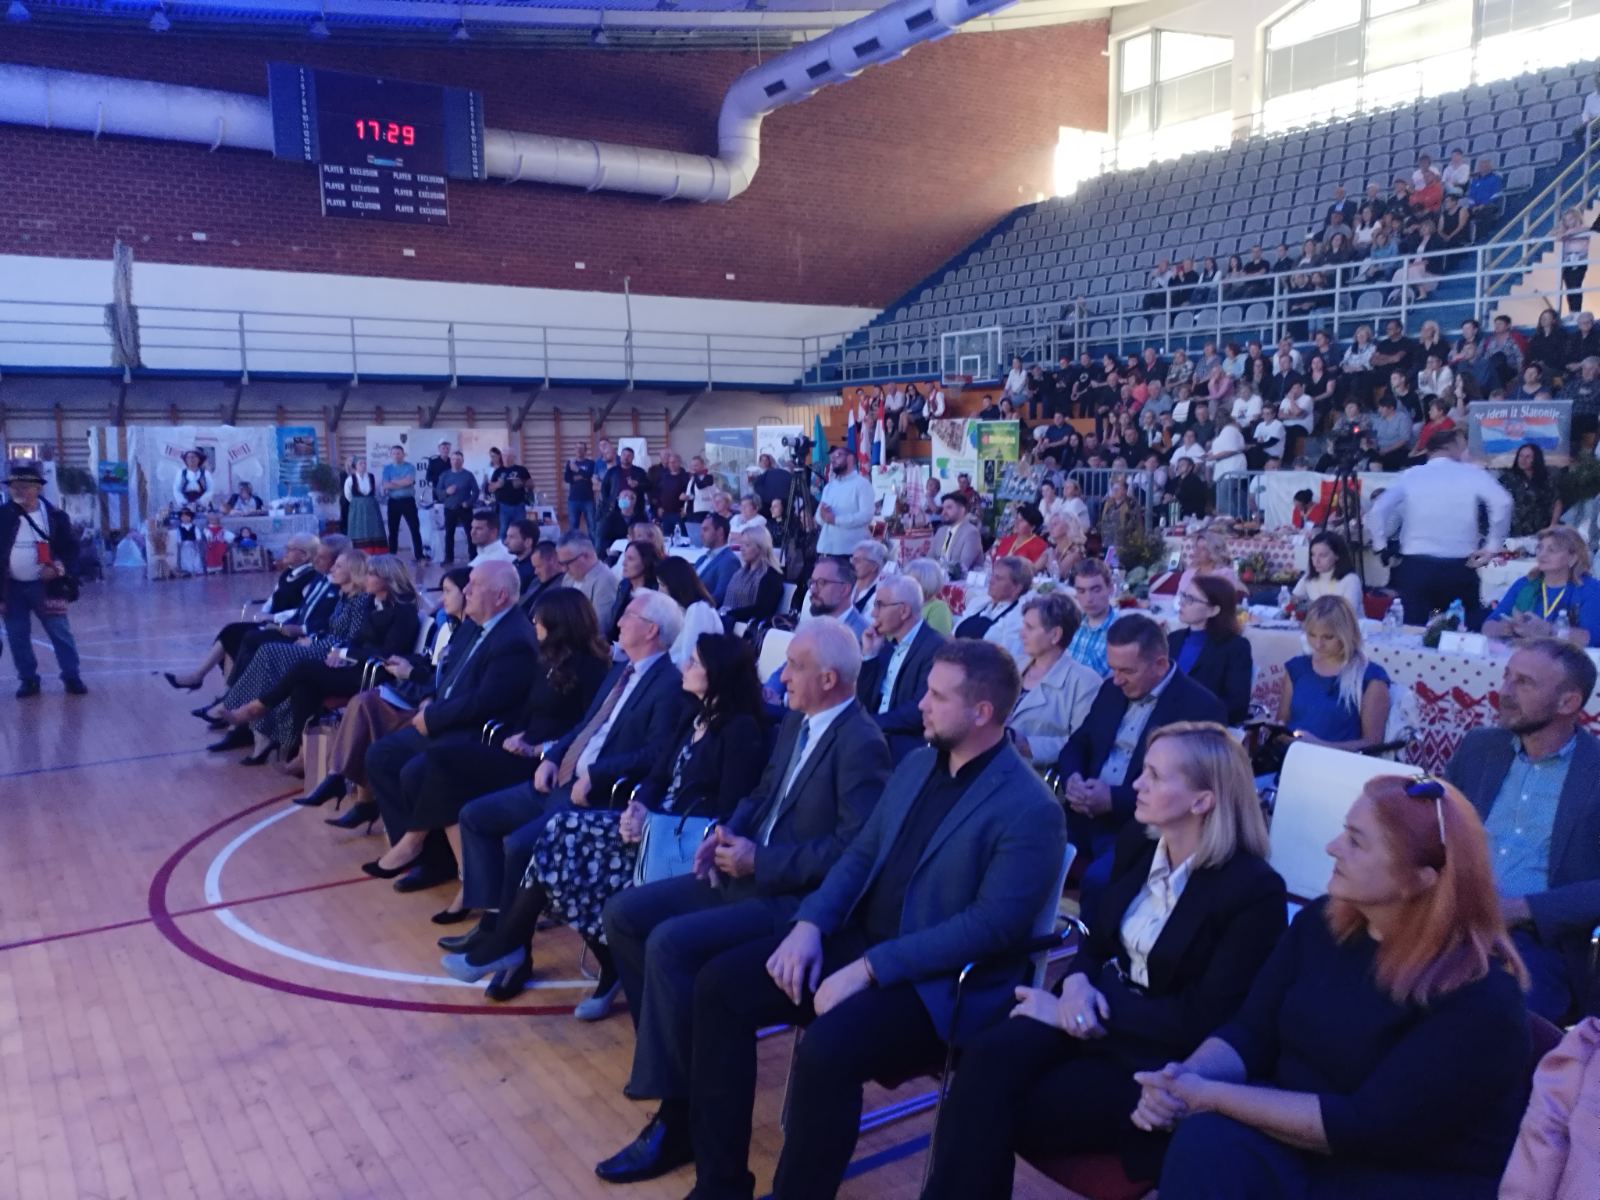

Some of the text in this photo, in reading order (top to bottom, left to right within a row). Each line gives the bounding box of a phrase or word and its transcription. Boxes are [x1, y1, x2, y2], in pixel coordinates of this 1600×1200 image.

[355, 119, 415, 146] 17:29
[324, 164, 378, 177] PLAYER EXCLUSION
[393, 172, 444, 184] PLAYER EXCLUSION
[325, 182, 380, 194] PLAYER EXCLUSION
[394, 188, 445, 200] PLAYER EXCLUSION
[327, 199, 381, 210] PLAYER EXCLUSION
[395, 205, 446, 216] PLAYER EXCLUSION
[1487, 408, 1508, 419] idem
